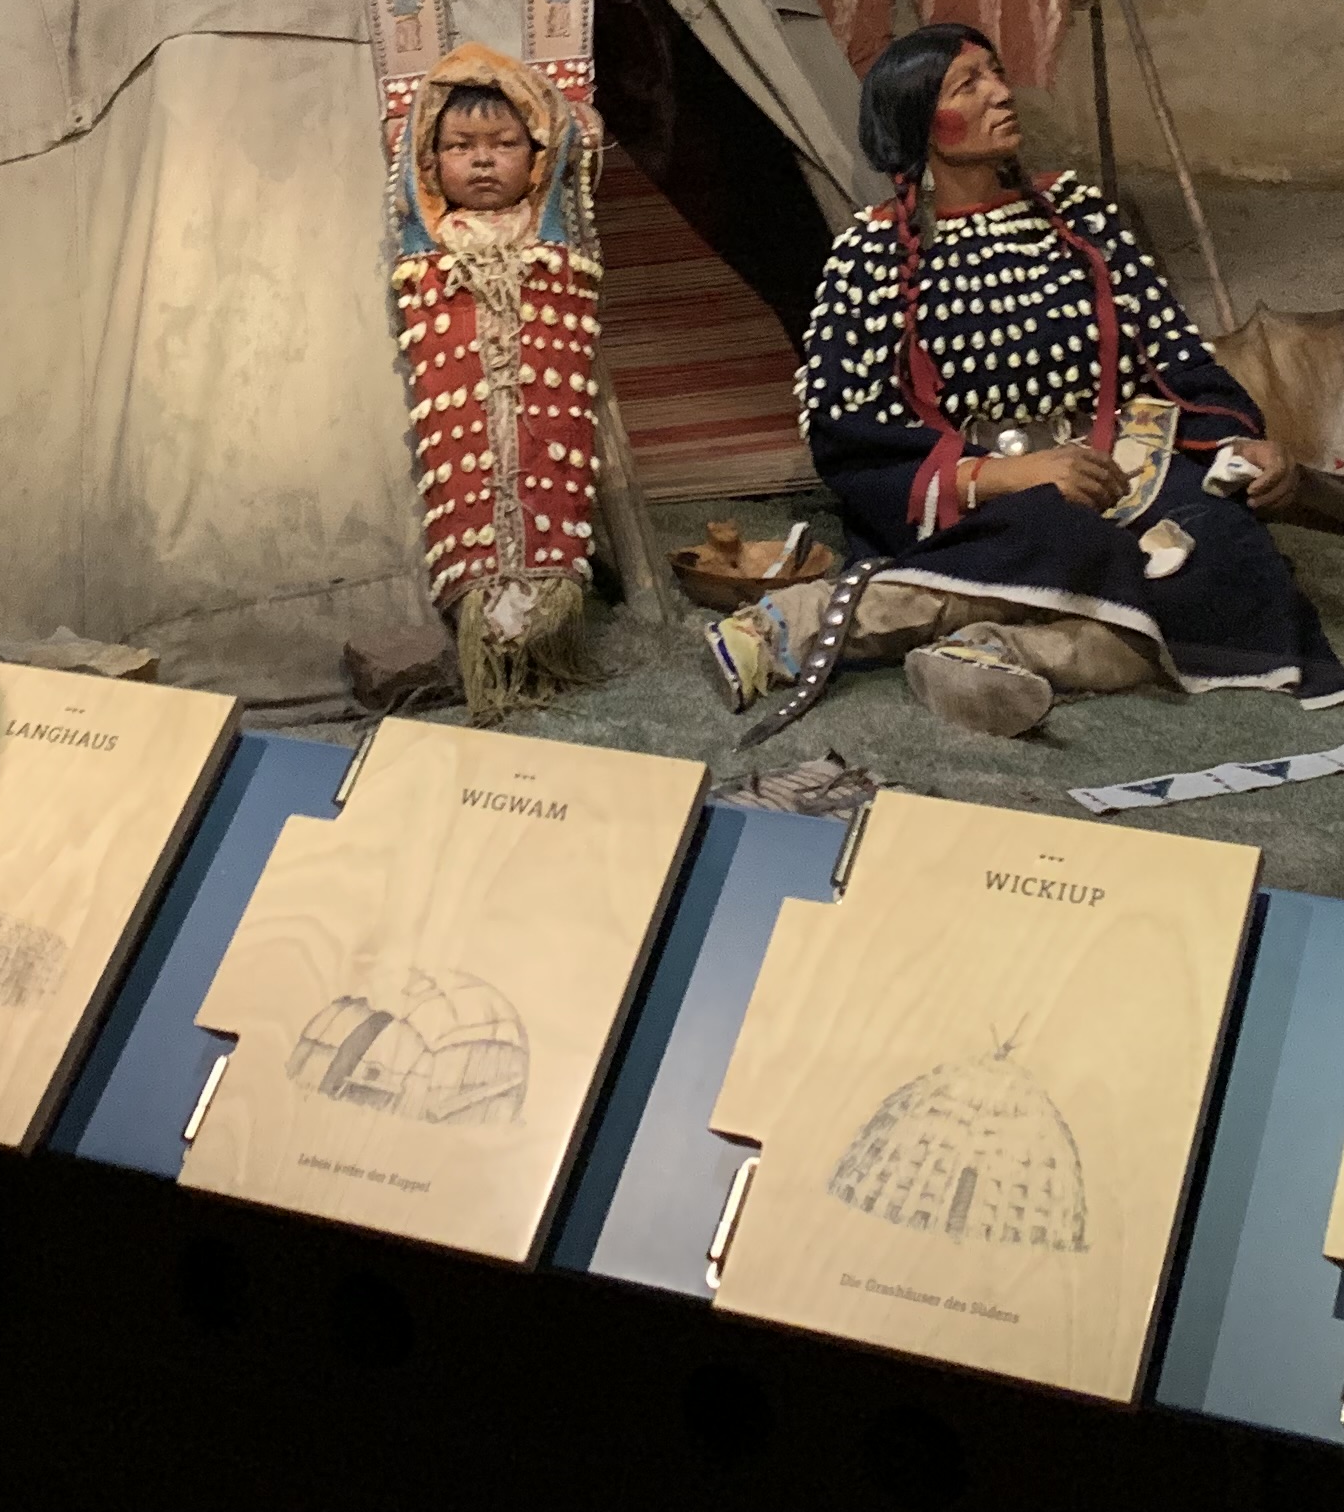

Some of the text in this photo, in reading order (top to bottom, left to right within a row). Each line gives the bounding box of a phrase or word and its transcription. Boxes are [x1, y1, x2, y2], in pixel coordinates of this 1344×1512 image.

[5, 719, 119, 751] LANGHAUS
[461, 788, 568, 821] WIGWAM
[986, 870, 1105, 907] WICKIUP
